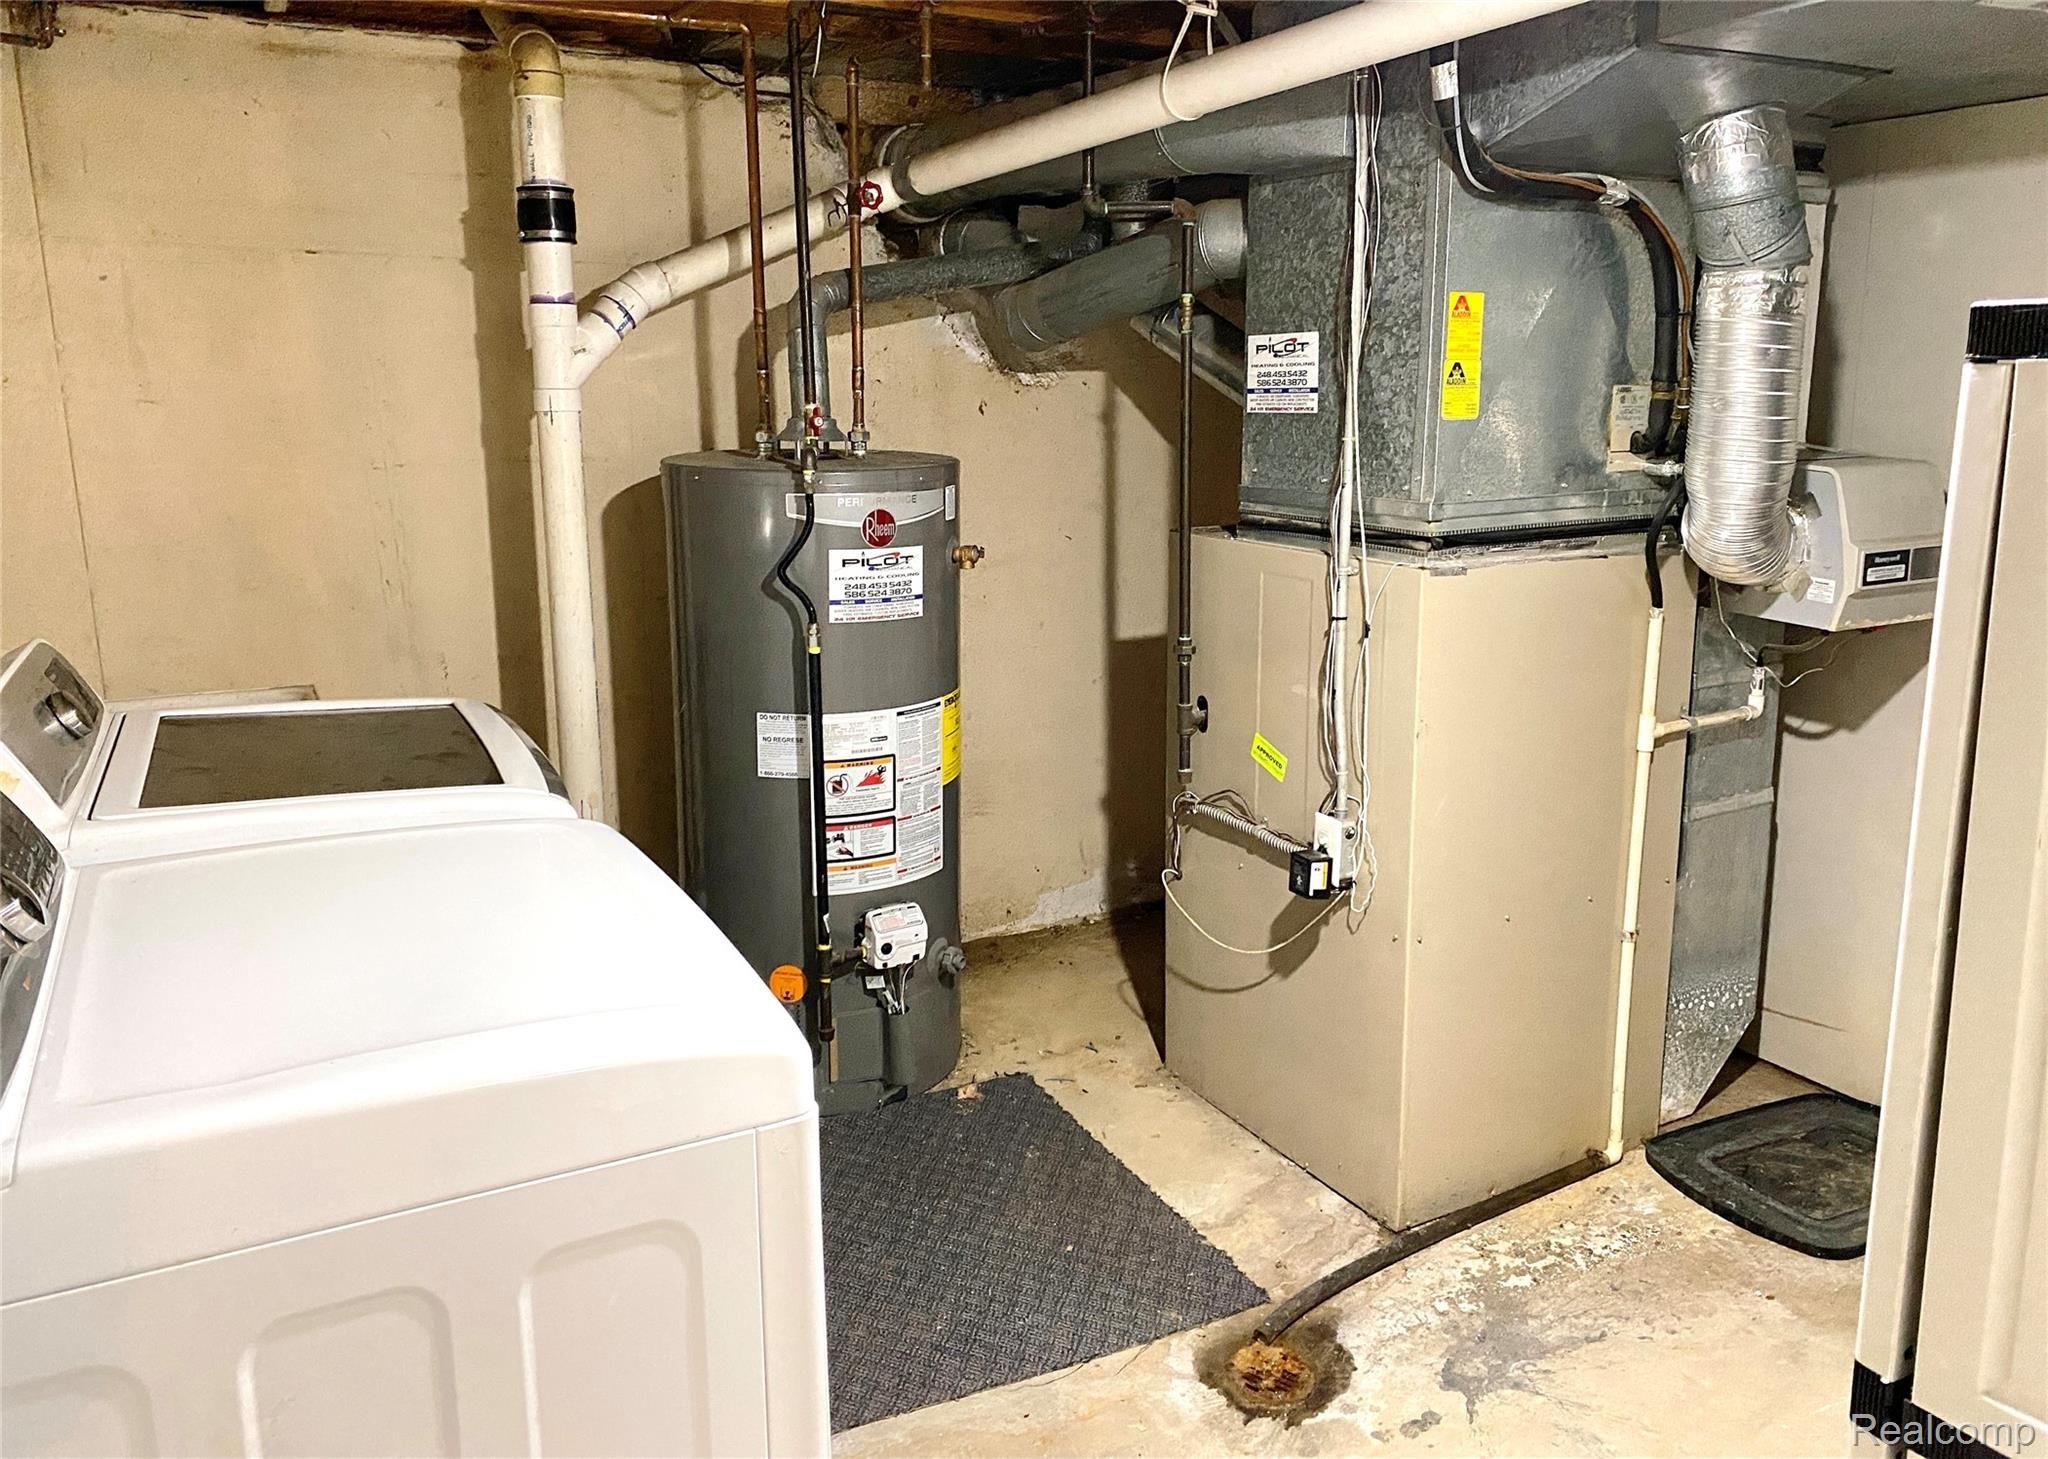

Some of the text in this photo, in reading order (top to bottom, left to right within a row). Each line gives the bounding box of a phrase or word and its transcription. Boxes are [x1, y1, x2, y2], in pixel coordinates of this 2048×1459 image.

[1256, 338, 1309, 355] PILOT
[865, 509, 895, 542] Rheem
[841, 552, 914, 568] PILOT
[1256, 744, 1283, 770] APPROVED
